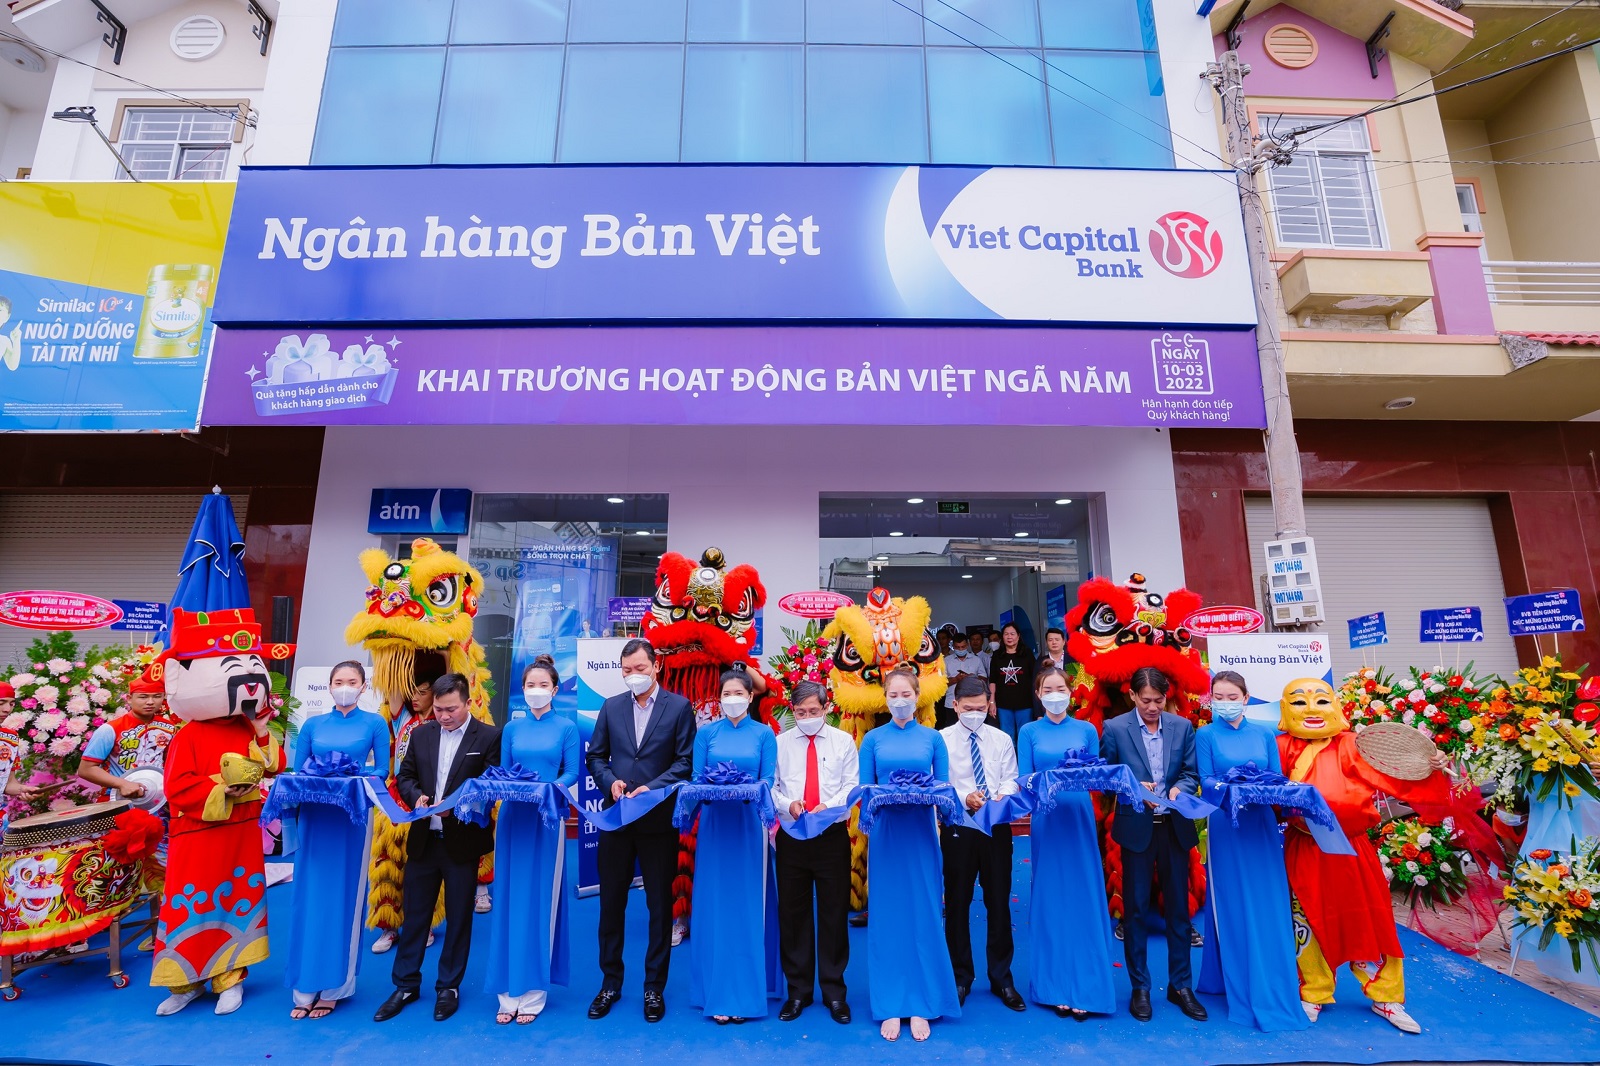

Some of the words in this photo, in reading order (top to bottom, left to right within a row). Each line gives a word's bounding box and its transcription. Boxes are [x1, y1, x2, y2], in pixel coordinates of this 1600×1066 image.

[258, 216, 407, 270] Ngân
[420, 215, 567, 268] hàng
[580, 213, 695, 256] Bản
[706, 213, 821, 264] Việt
[942, 223, 1010, 250] Viet
[1019, 226, 1140, 257] Capital
[1077, 259, 1143, 278] Bank
[37, 298, 95, 312] Similac
[124, 300, 133, 312] 4
[155, 310, 196, 321] Similac
[24, 318, 68, 340] NUÔI
[73, 317, 134, 340] DƯỠNG
[32, 342, 56, 362] TÀI
[60, 342, 87, 362] TRÍ
[89, 342, 122, 362] NHÍ
[1162, 347, 1200, 360] NGÀY
[1162, 364, 1204, 376] 10-03
[418, 370, 490, 392] KHAI
[498, 366, 629, 392] TRƯƠNG
[638, 369, 724, 398] HOẠT
[731, 364, 826, 398] ĐỘNG
[836, 362, 900, 392] BẢN
[908, 365, 976, 398] VIỆT
[985, 365, 1052, 393] NGÃ
[1060, 366, 1132, 394] NĂM
[1166, 378, 1204, 390] 2022
[256, 390, 274, 400] Quà
[276, 388, 296, 399] tặng
[298, 386, 316, 396] hấp
[318, 384, 334, 394] dẫn
[337, 382, 360, 392] dành
[362, 381, 378, 390] cho
[272, 399, 298, 410] khách
[300, 398, 324, 408] hàng
[326, 396, 345, 407] giao
[347, 394, 366, 404] dịch
[1142, 399, 1162, 408] Hân
[1164, 399, 1190, 410] hạnh
[1192, 400, 1212, 408] đón
[1214, 399, 1233, 410] tiếp
[1148, 410, 1168, 422] Quý
[1170, 410, 1200, 420] khách
[1202, 411, 1230, 422] hàng!
[380, 502, 420, 520] atm
[587, 660, 610, 672] Ngân
[1220, 655, 1247, 665] Ngân
[1250, 655, 1276, 665] hàng
[1279, 655, 1300, 663] Bản
[1302, 655, 1323, 665] Việt
